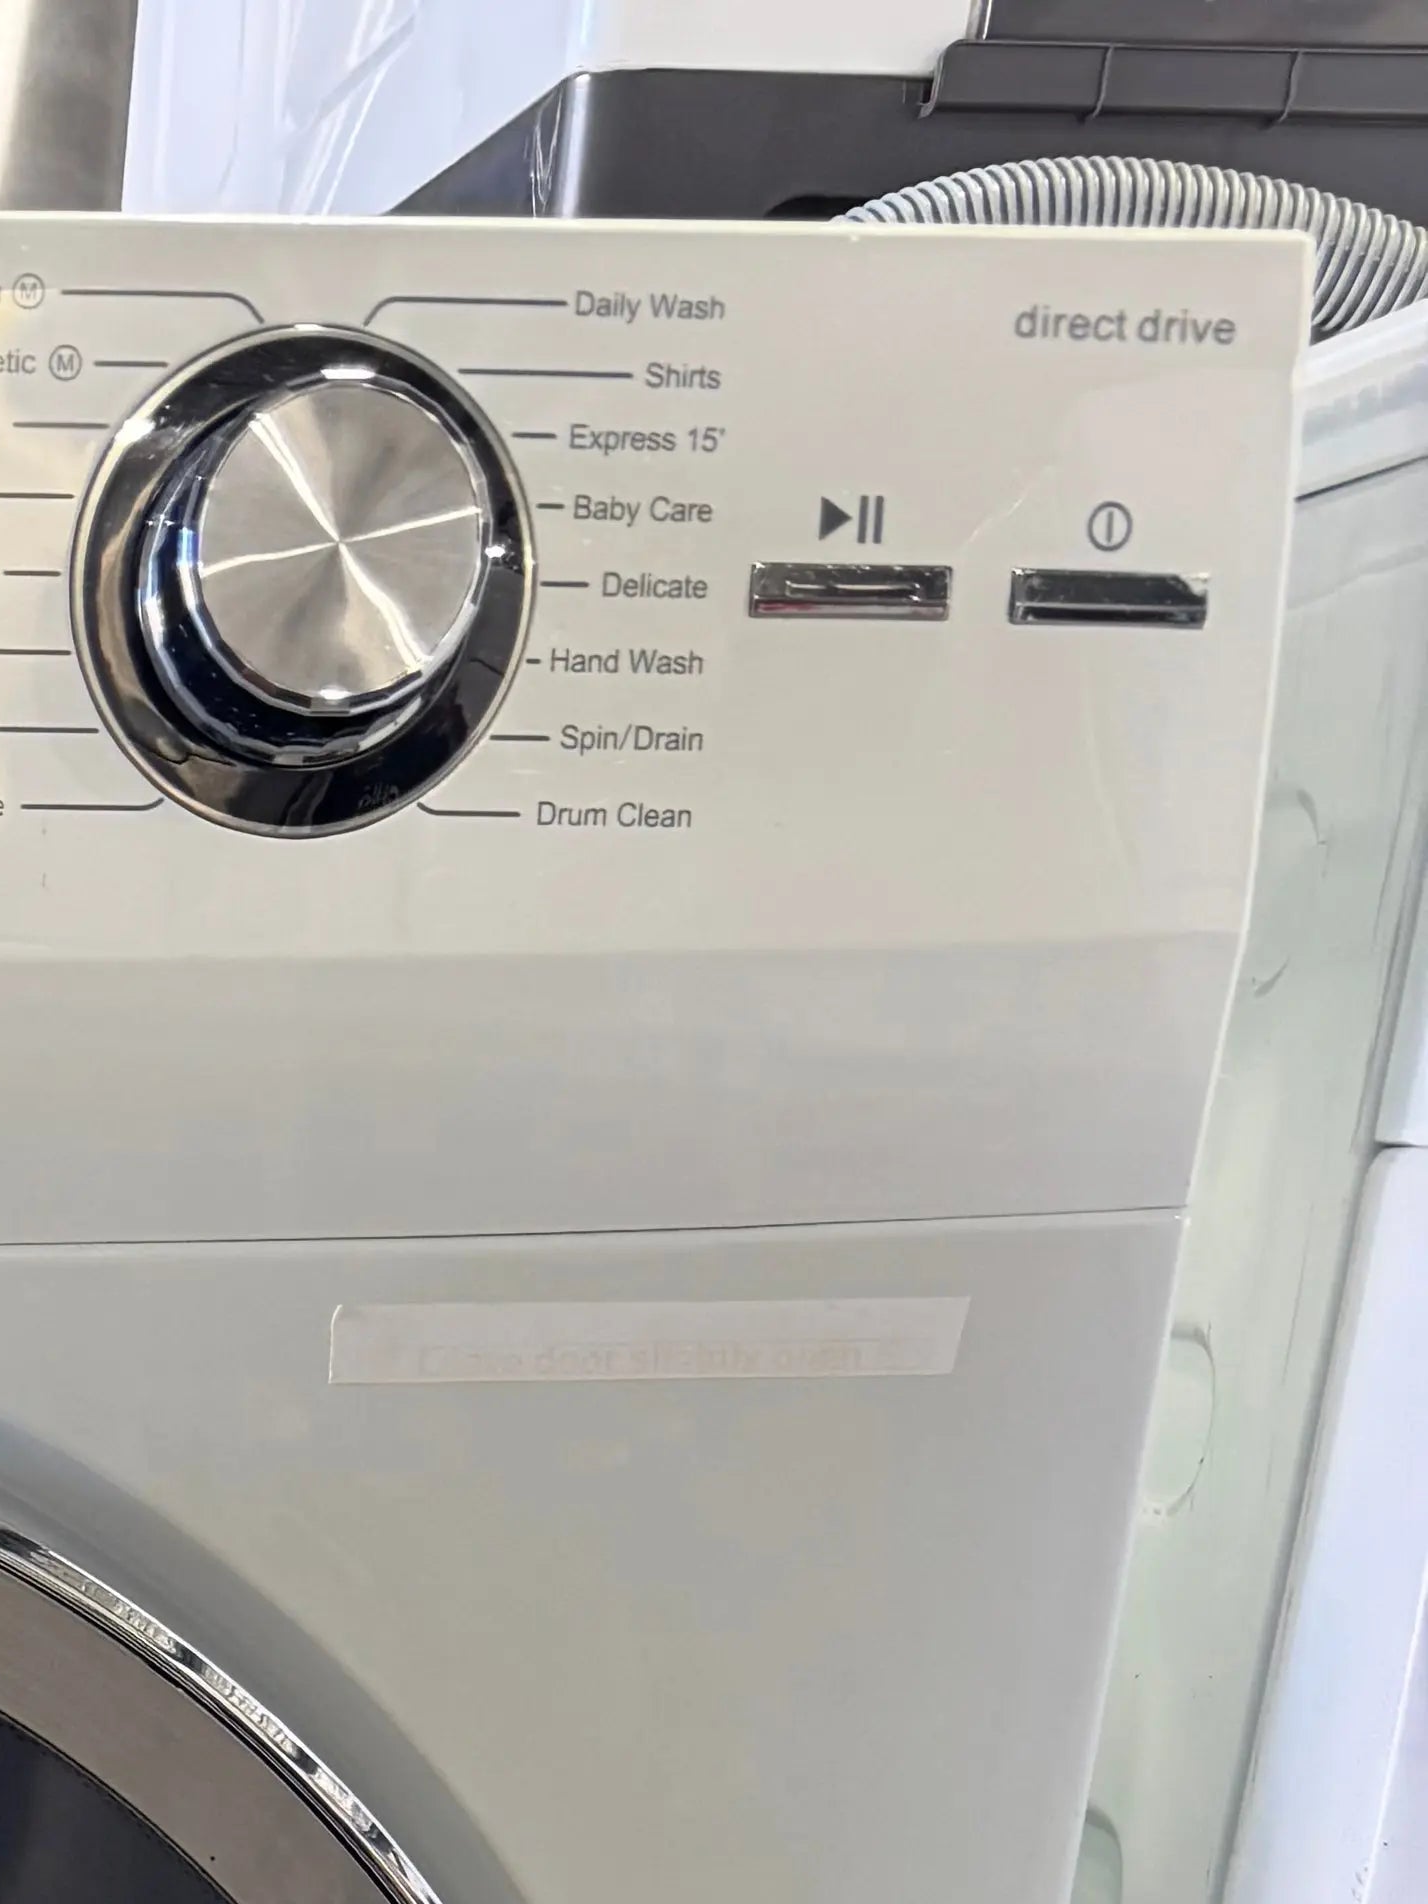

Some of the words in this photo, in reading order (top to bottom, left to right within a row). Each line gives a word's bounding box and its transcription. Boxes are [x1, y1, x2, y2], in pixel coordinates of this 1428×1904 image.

[574, 291, 641, 324] Daily
[649, 293, 726, 321] Wash
[1015, 306, 1127, 342] direct
[1137, 309, 1236, 346] drive
[645, 363, 721, 389] Shirts
[569, 424, 678, 456] Express
[573, 496, 639, 528] Baby
[648, 498, 713, 524] Care
[602, 573, 708, 600] Delicate
[550, 648, 619, 674] Hand
[626, 649, 704, 675] Wash
[560, 724, 704, 756] Spin/Drain
[537, 803, 607, 828] Drum
[616, 803, 692, 828] Clean
